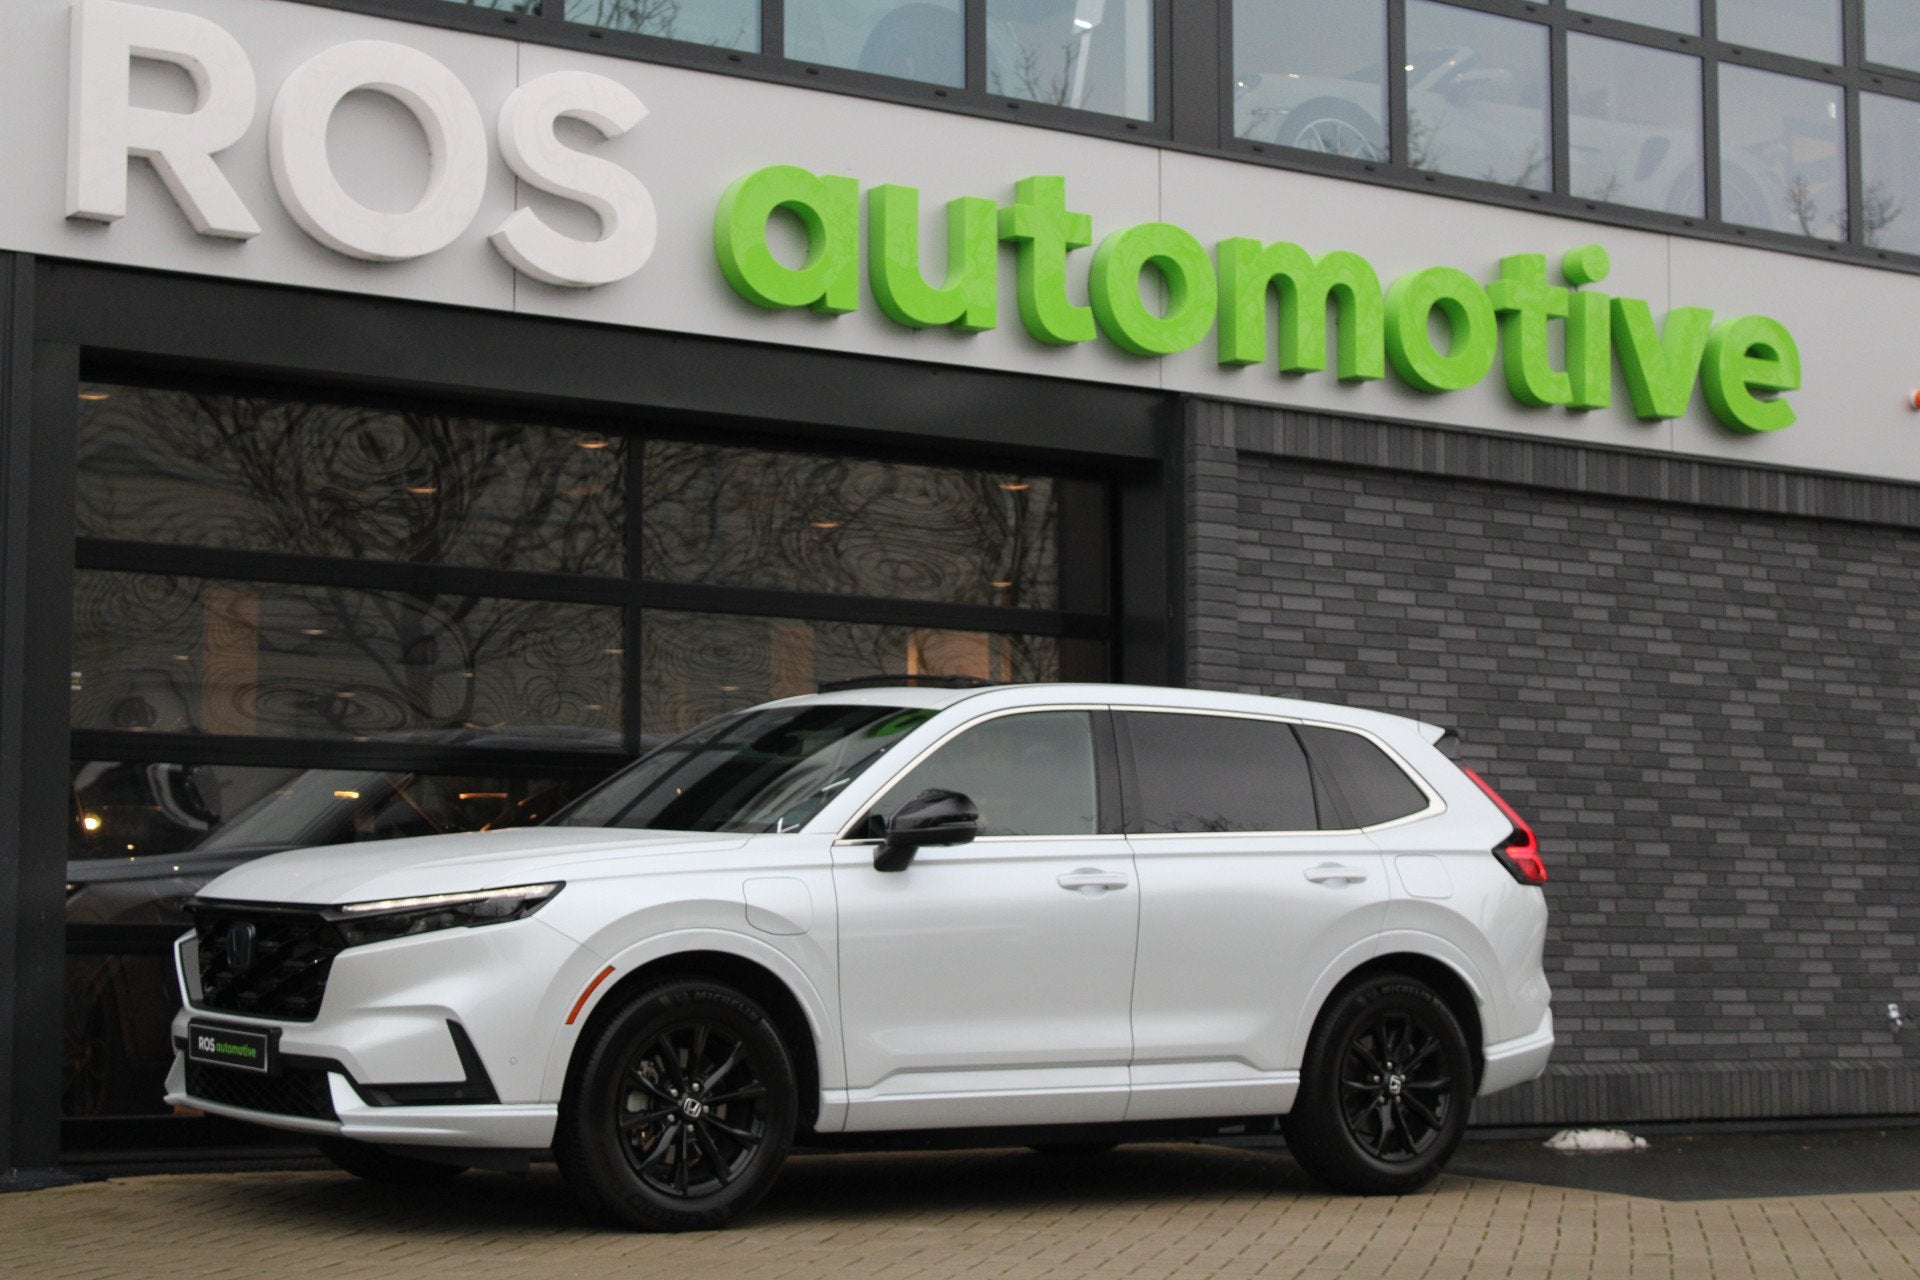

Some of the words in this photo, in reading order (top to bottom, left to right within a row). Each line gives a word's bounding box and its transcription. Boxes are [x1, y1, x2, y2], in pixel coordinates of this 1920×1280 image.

[66, 1, 658, 288] ROS
[713, 165, 1801, 433] automotive
[198, 1035, 215, 1053] ROS
[216, 1042, 257, 1058] automotive
